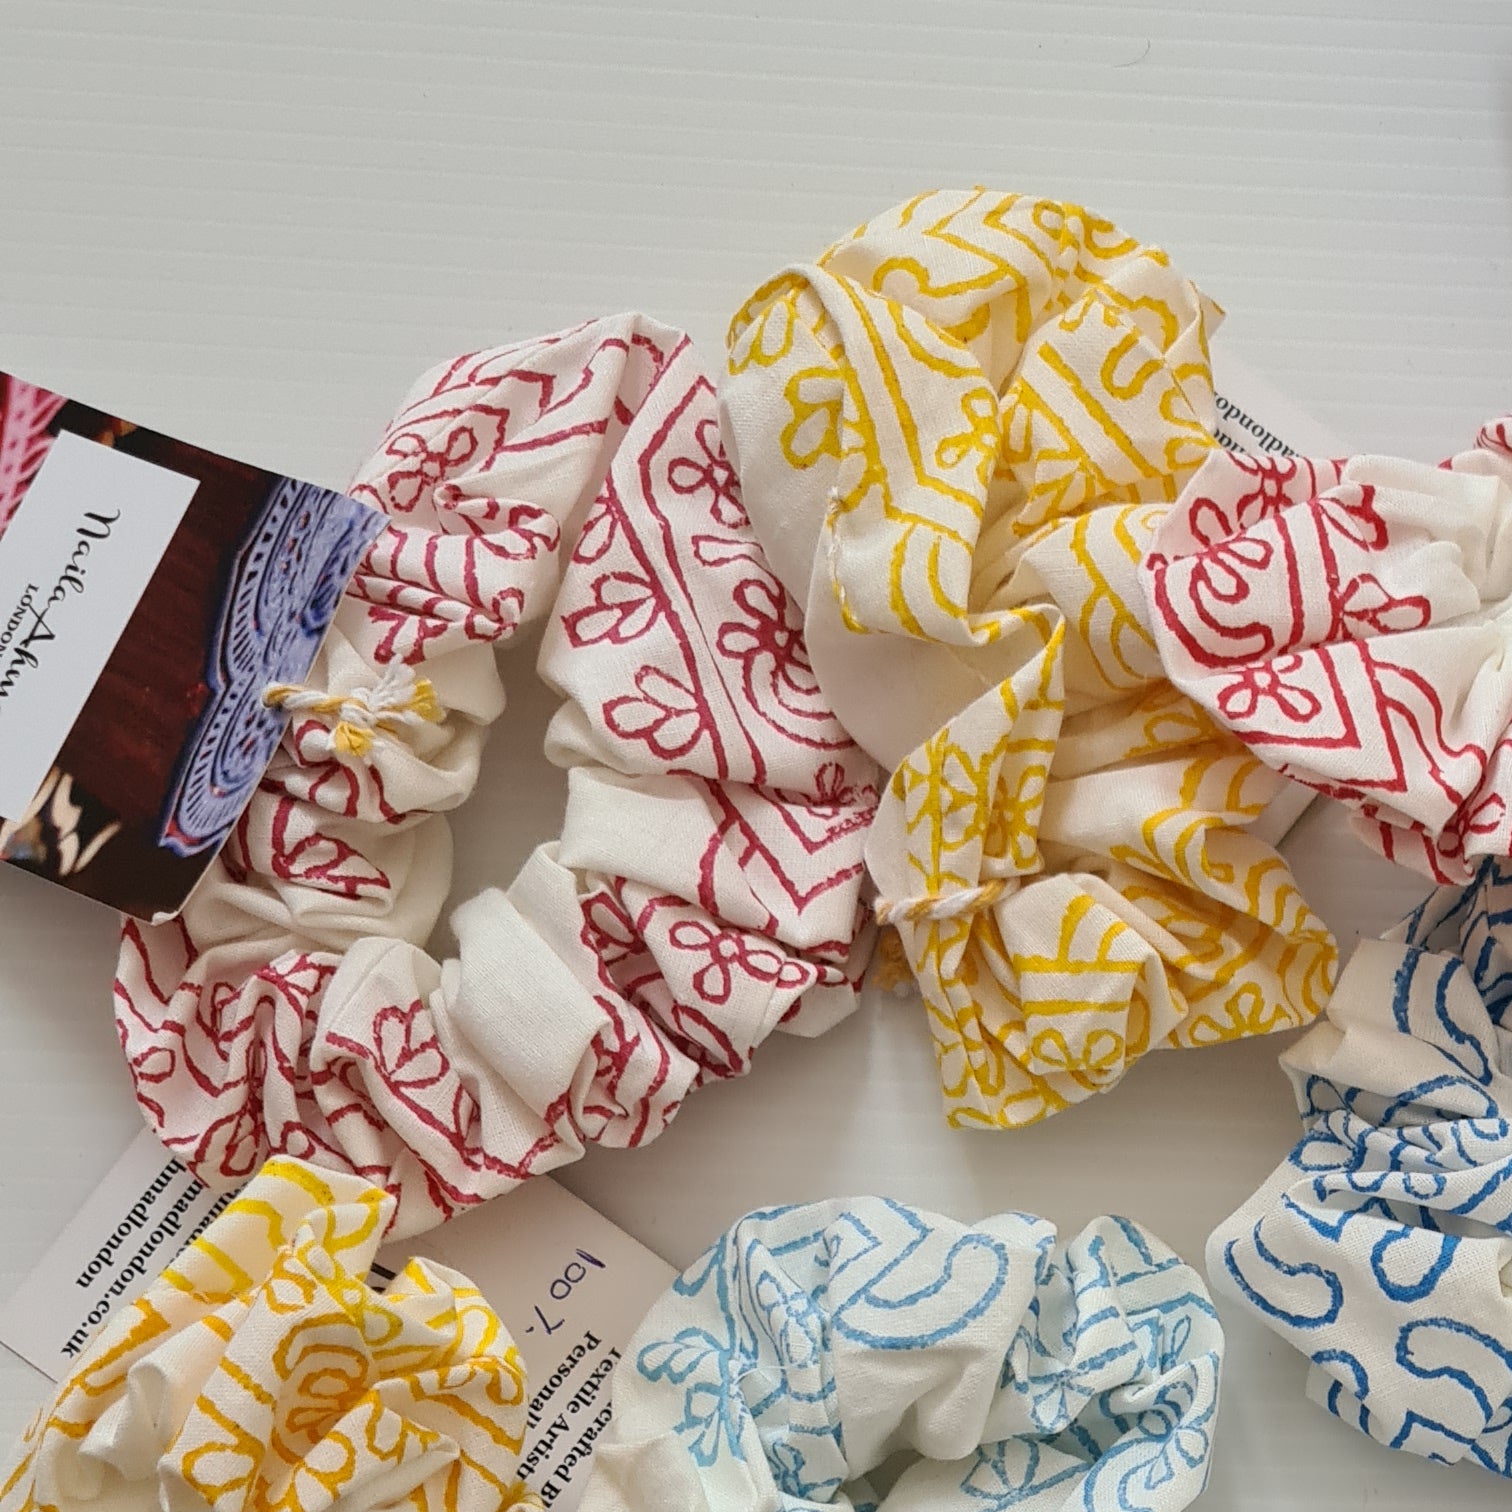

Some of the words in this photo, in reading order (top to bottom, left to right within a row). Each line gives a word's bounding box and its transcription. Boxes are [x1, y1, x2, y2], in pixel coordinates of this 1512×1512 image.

[1214, 393, 1299, 458] adlondo
[47, 508, 121, 609] Naila
[554, 1402, 613, 1483] crafted
